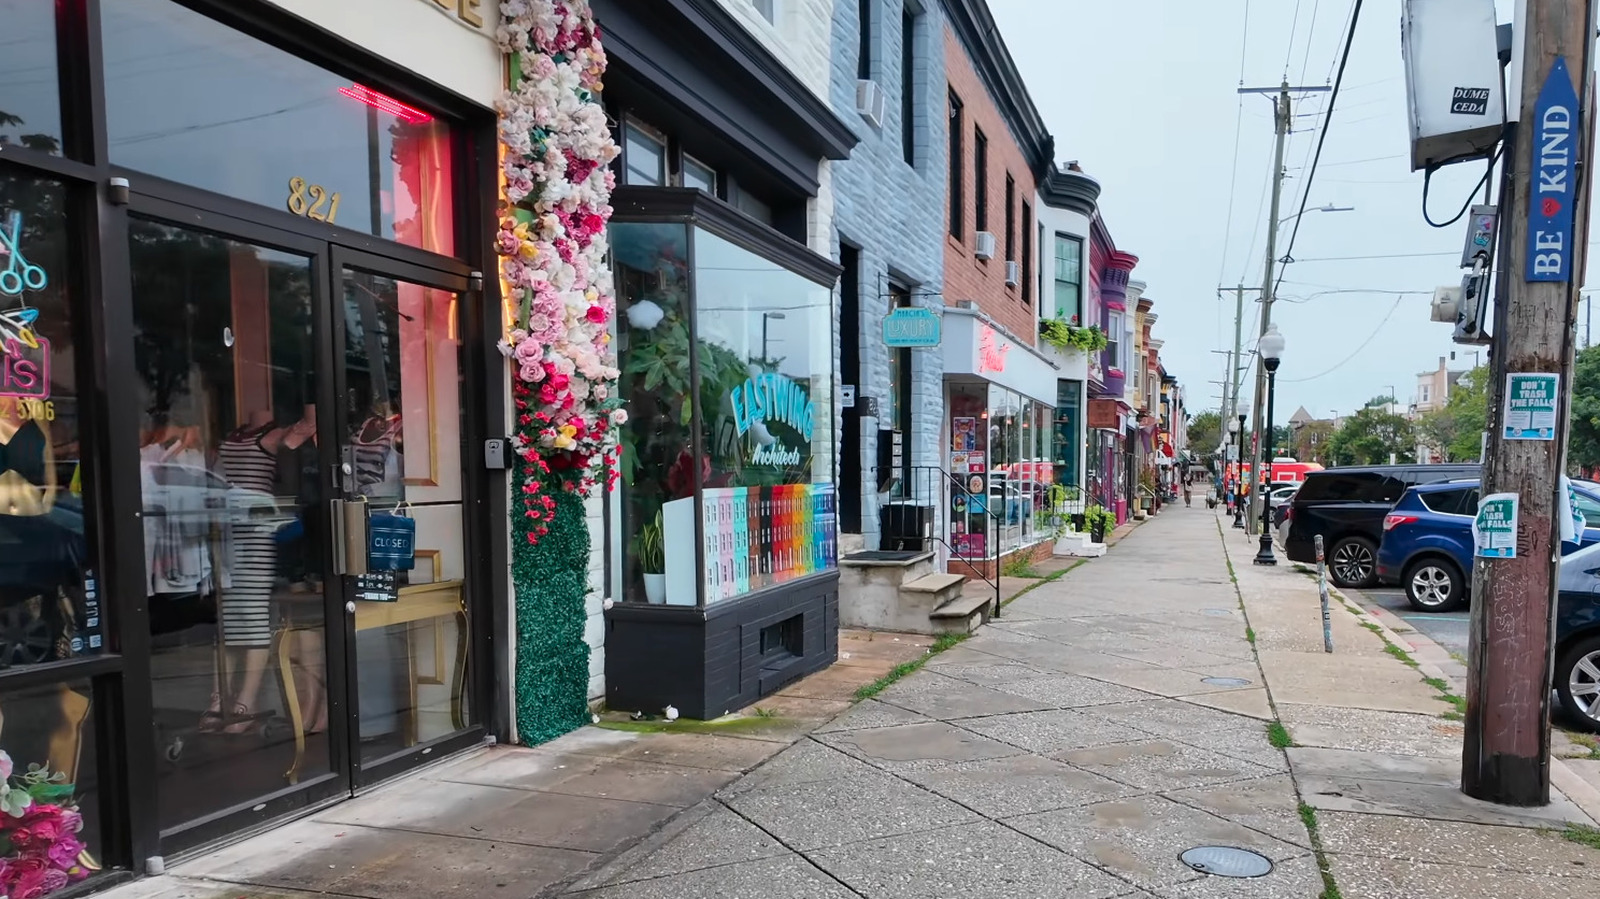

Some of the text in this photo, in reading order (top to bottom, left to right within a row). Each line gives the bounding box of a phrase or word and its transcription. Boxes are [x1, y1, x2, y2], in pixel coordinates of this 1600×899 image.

[1453, 89, 1489, 99] DUME
[1453, 102, 1485, 113] CEDA
[1533, 105, 1570, 275] BE KIND
[287, 175, 341, 226] 821
[887, 319, 935, 338] LUXURY
[1521, 380, 1546, 390] DON'T
[1519, 390, 1547, 399] TRASH
[730, 372, 815, 444] EASTWING
[1511, 398, 1554, 407] THE FALLS
[1487, 519, 1513, 528] FALLS
[374, 537, 409, 549] CLOSED
